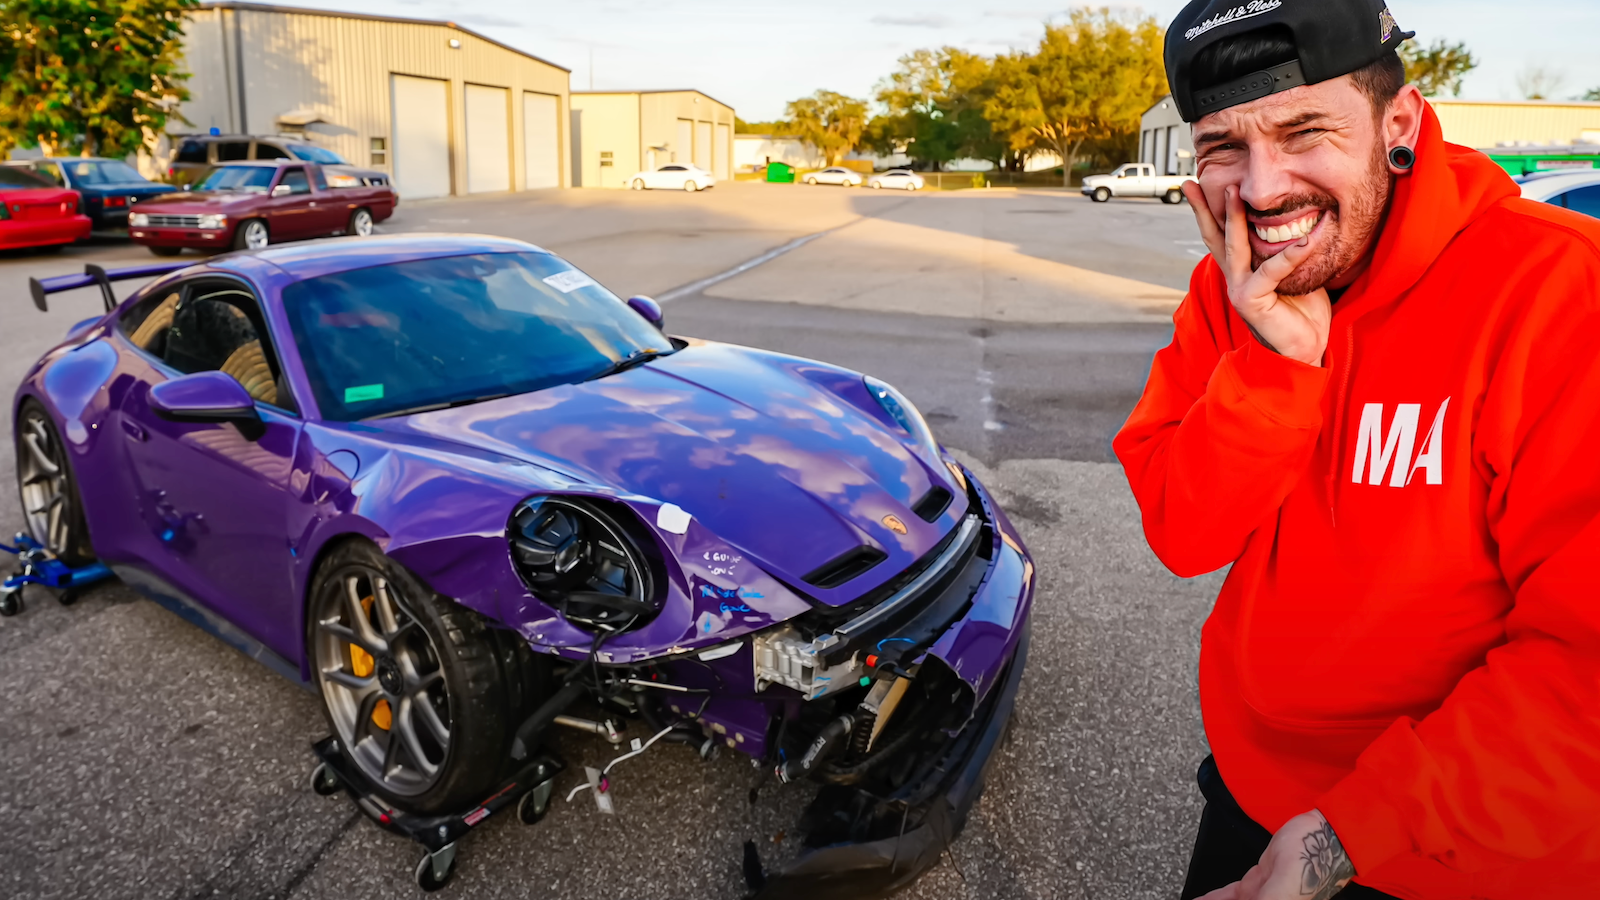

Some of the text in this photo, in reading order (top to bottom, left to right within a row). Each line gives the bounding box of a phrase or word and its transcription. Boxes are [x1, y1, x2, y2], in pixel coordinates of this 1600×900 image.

[1184, 0, 1282, 39] Mitchell & Ness
[1352, 396, 1451, 488] MA
